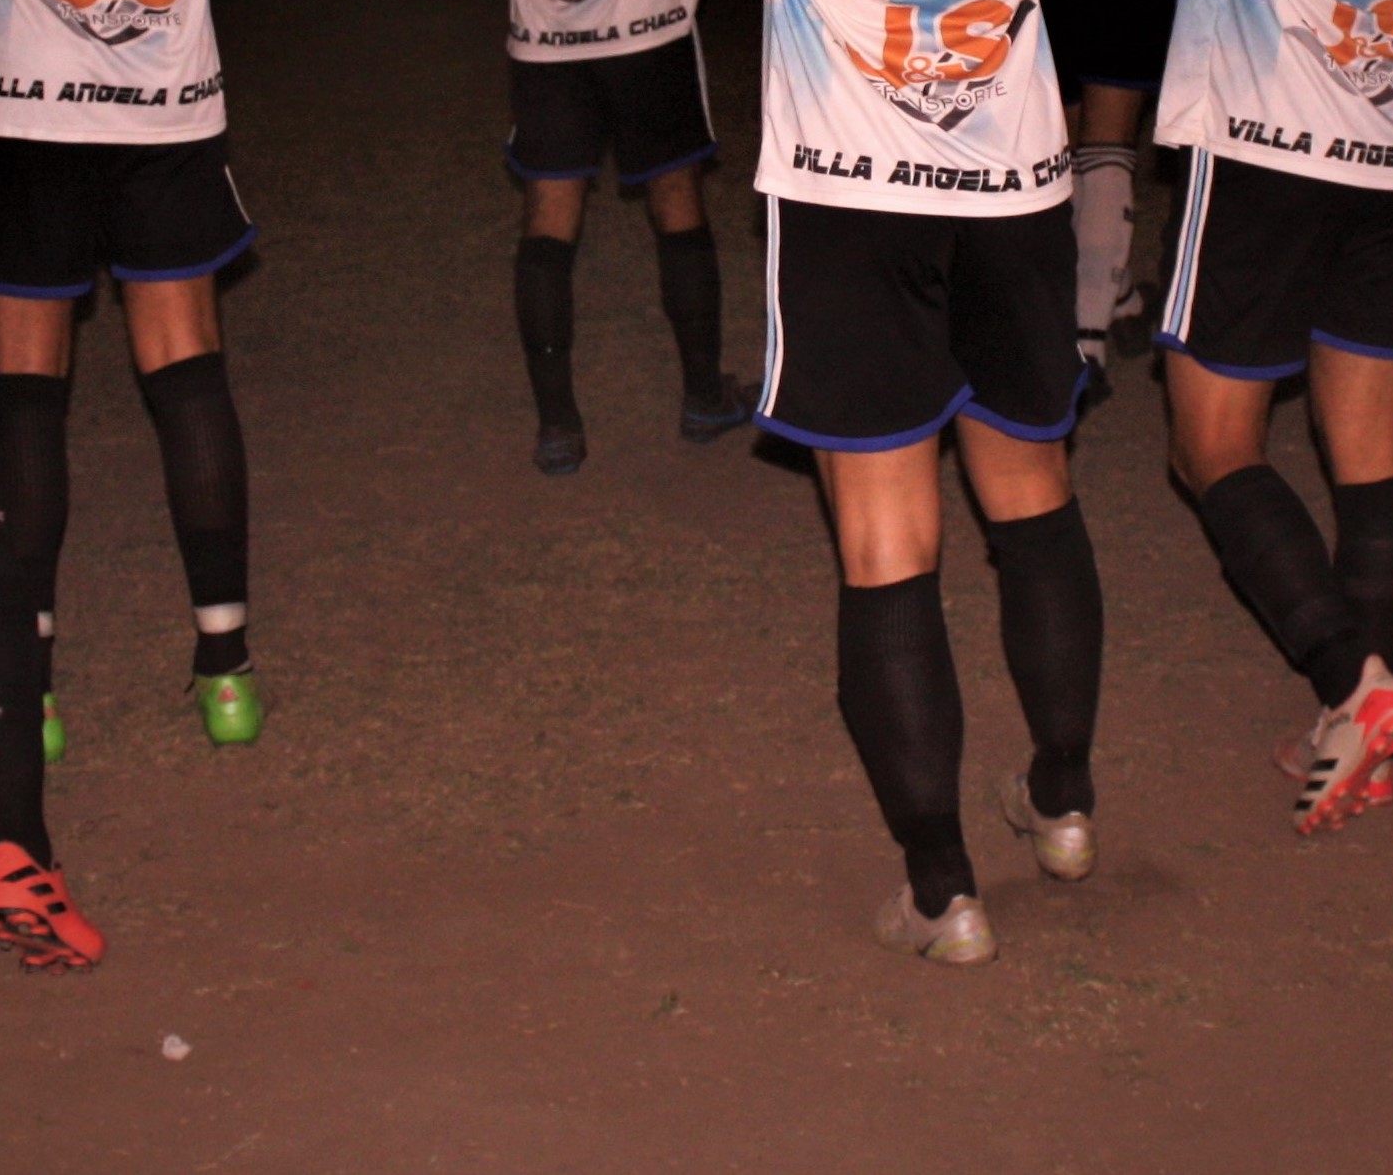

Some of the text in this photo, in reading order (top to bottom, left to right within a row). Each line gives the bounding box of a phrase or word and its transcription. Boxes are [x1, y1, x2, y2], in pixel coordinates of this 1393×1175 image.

[538, 26, 620, 46] ANGELA
[629, 6, 687, 36] CHACO
[56, 81, 167, 106] ANGELA
[1227, 116, 1313, 155] VILLA
[793, 144, 872, 180] VILLA
[888, 160, 1022, 192] ANGELA
